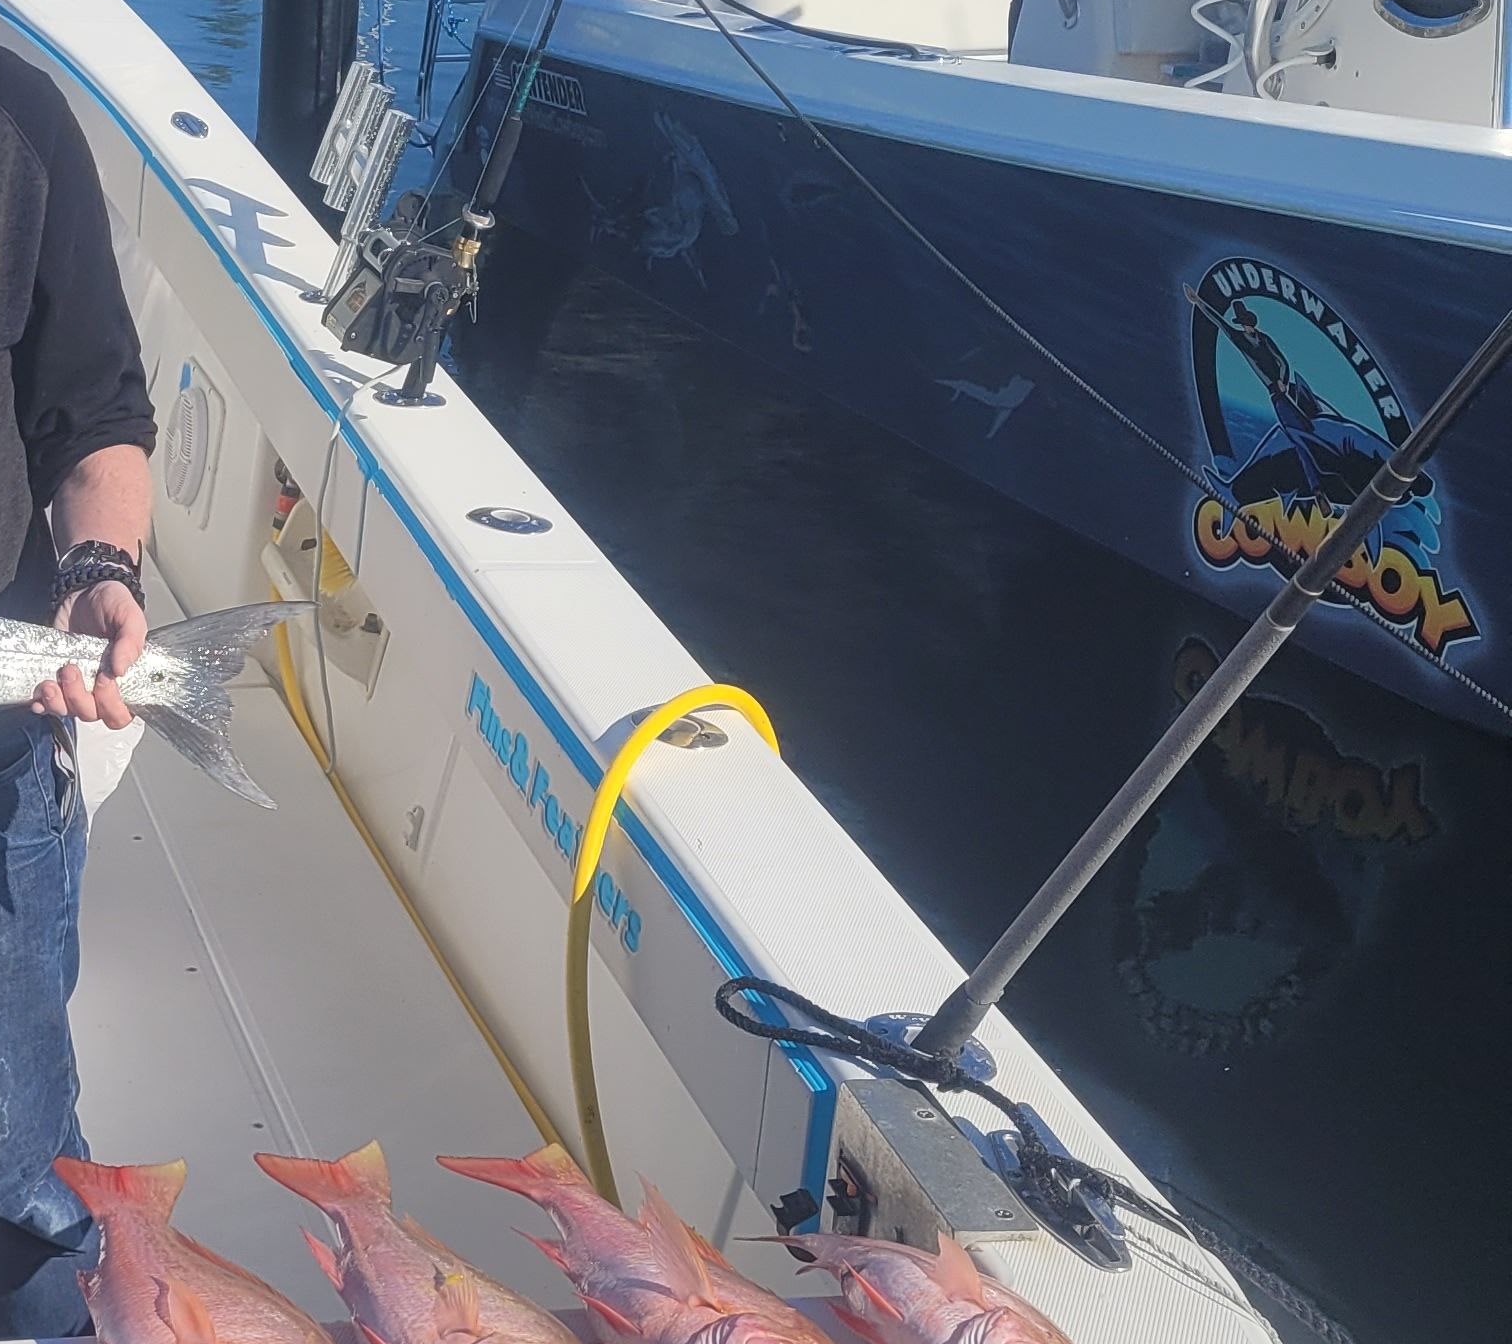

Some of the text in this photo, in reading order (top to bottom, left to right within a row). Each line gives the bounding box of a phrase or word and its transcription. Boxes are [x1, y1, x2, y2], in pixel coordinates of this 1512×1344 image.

[510, 60, 588, 116] CTENDER
[1212, 262, 1405, 422] UNDERWATER
[528, 756, 644, 956] Feaers
